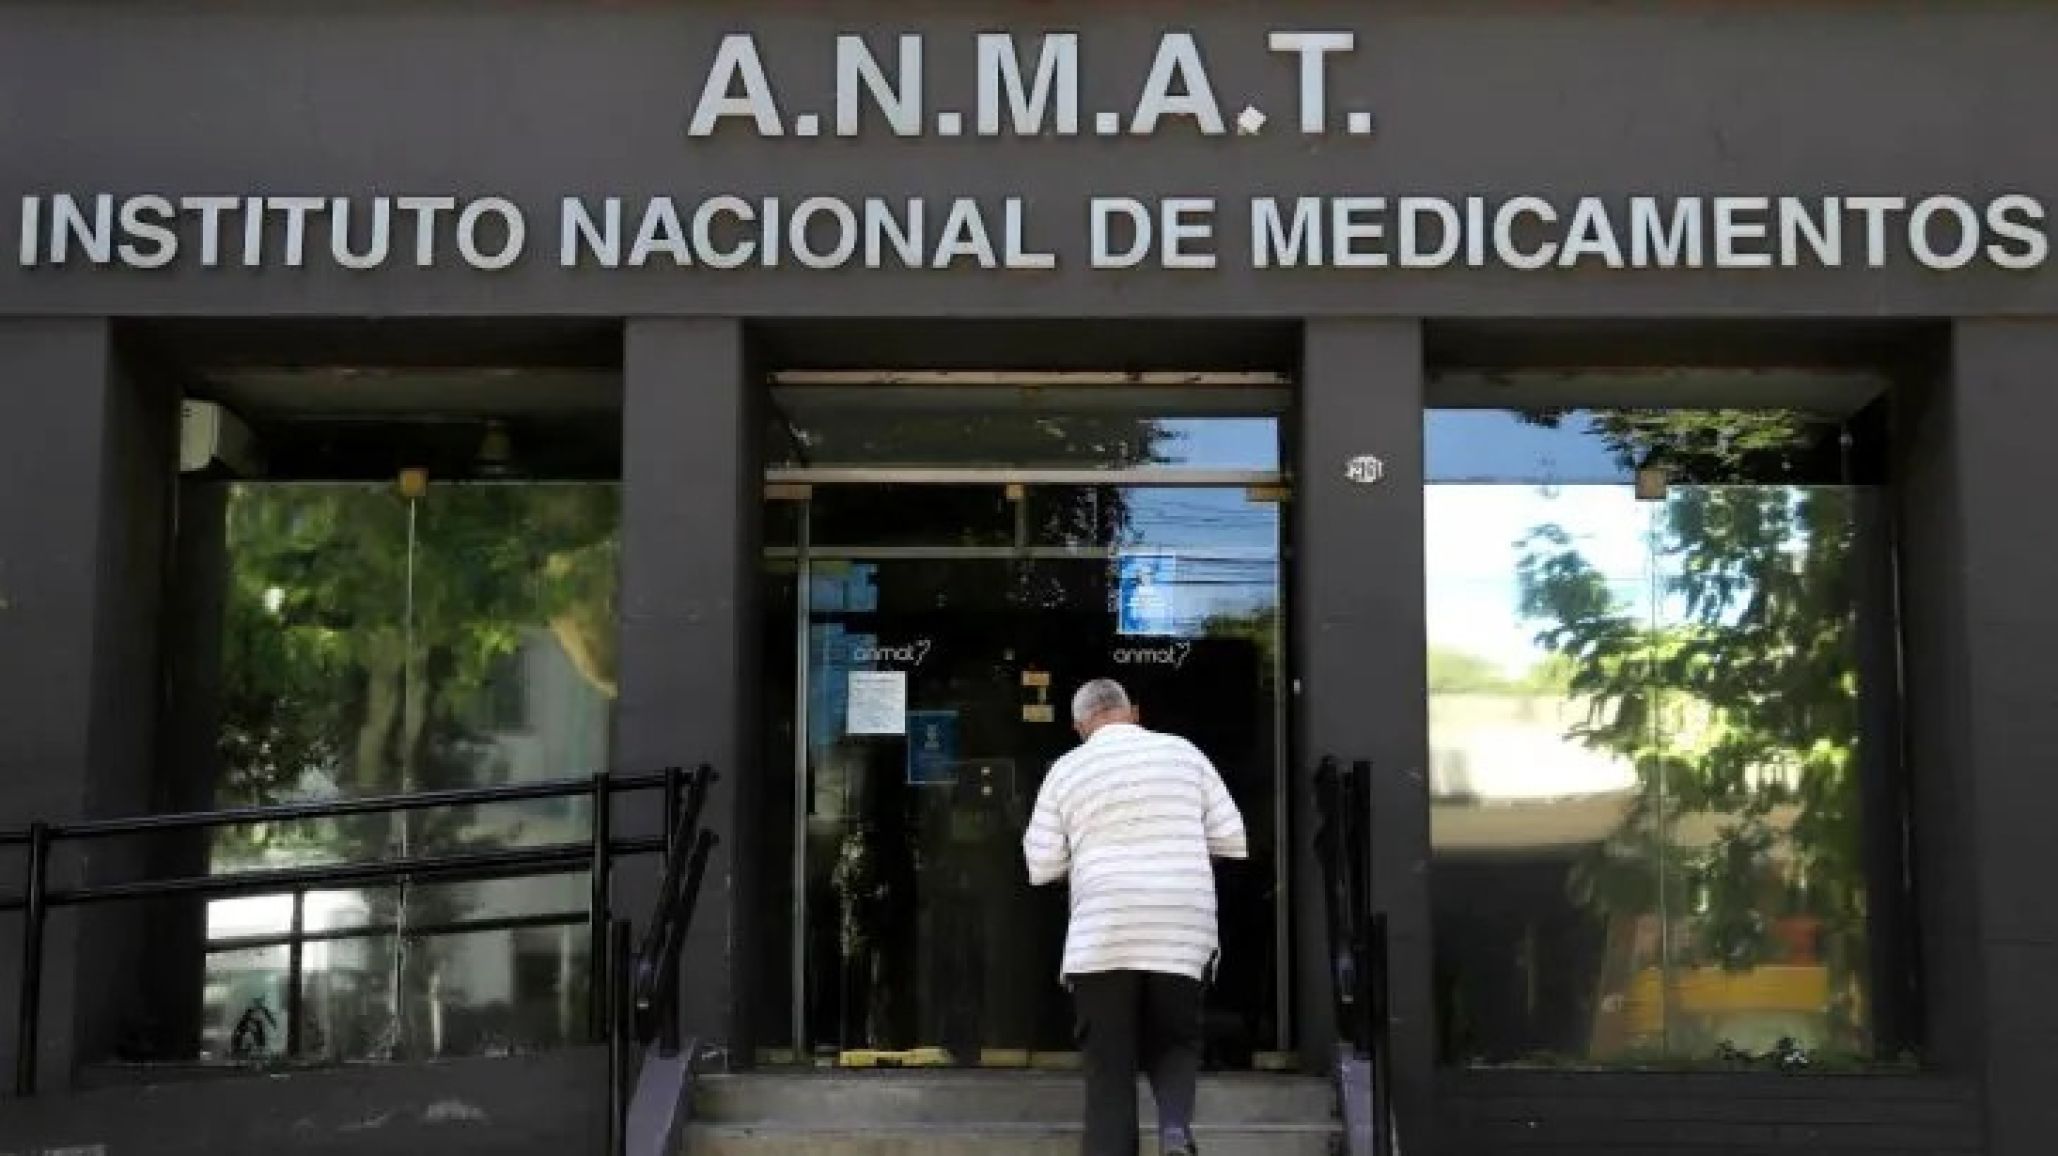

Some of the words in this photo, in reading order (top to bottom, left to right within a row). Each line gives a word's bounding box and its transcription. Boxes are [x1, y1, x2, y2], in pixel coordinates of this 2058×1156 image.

[688, 32, 1372, 136] A.N.M.A.T.
[18, 193, 525, 269] INSTITUTO
[560, 195, 1055, 269] NACIONAL
[1089, 196, 1217, 269] DE
[1250, 194, 2048, 270] MEDICAMENTOS
[853, 645, 914, 661] anmat
[1113, 645, 1174, 663] anmat
